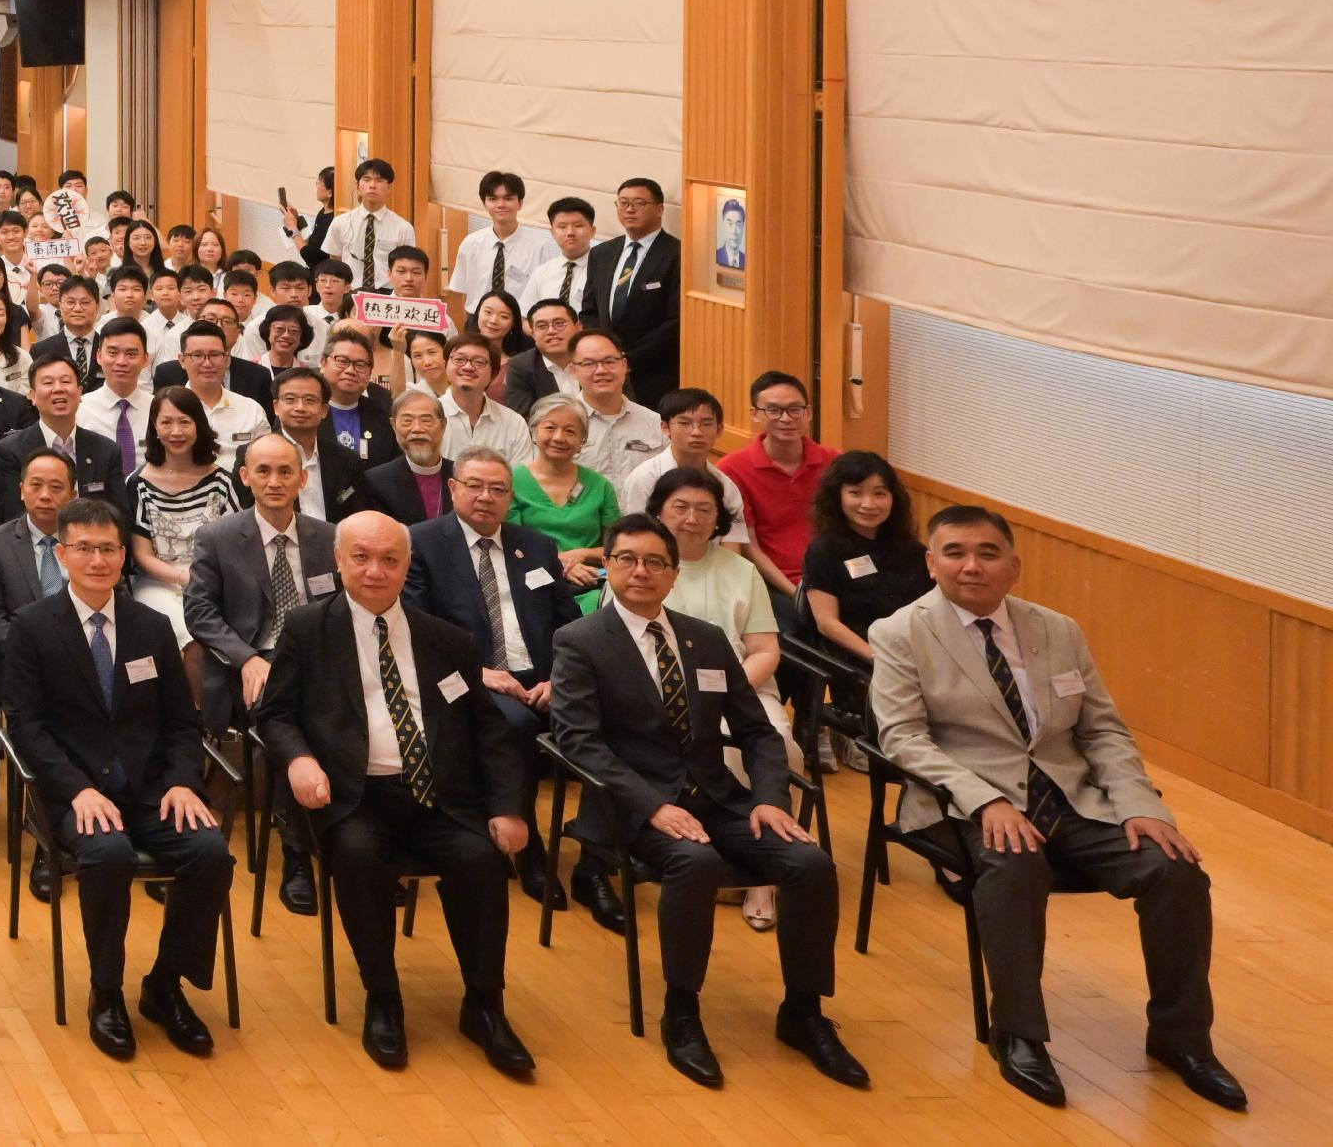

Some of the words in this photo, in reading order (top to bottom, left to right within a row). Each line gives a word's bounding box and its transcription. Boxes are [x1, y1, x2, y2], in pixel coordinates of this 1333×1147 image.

[33, 240, 71, 256] 黄雨婷
[365, 301, 440, 323] 热烈欢迎
